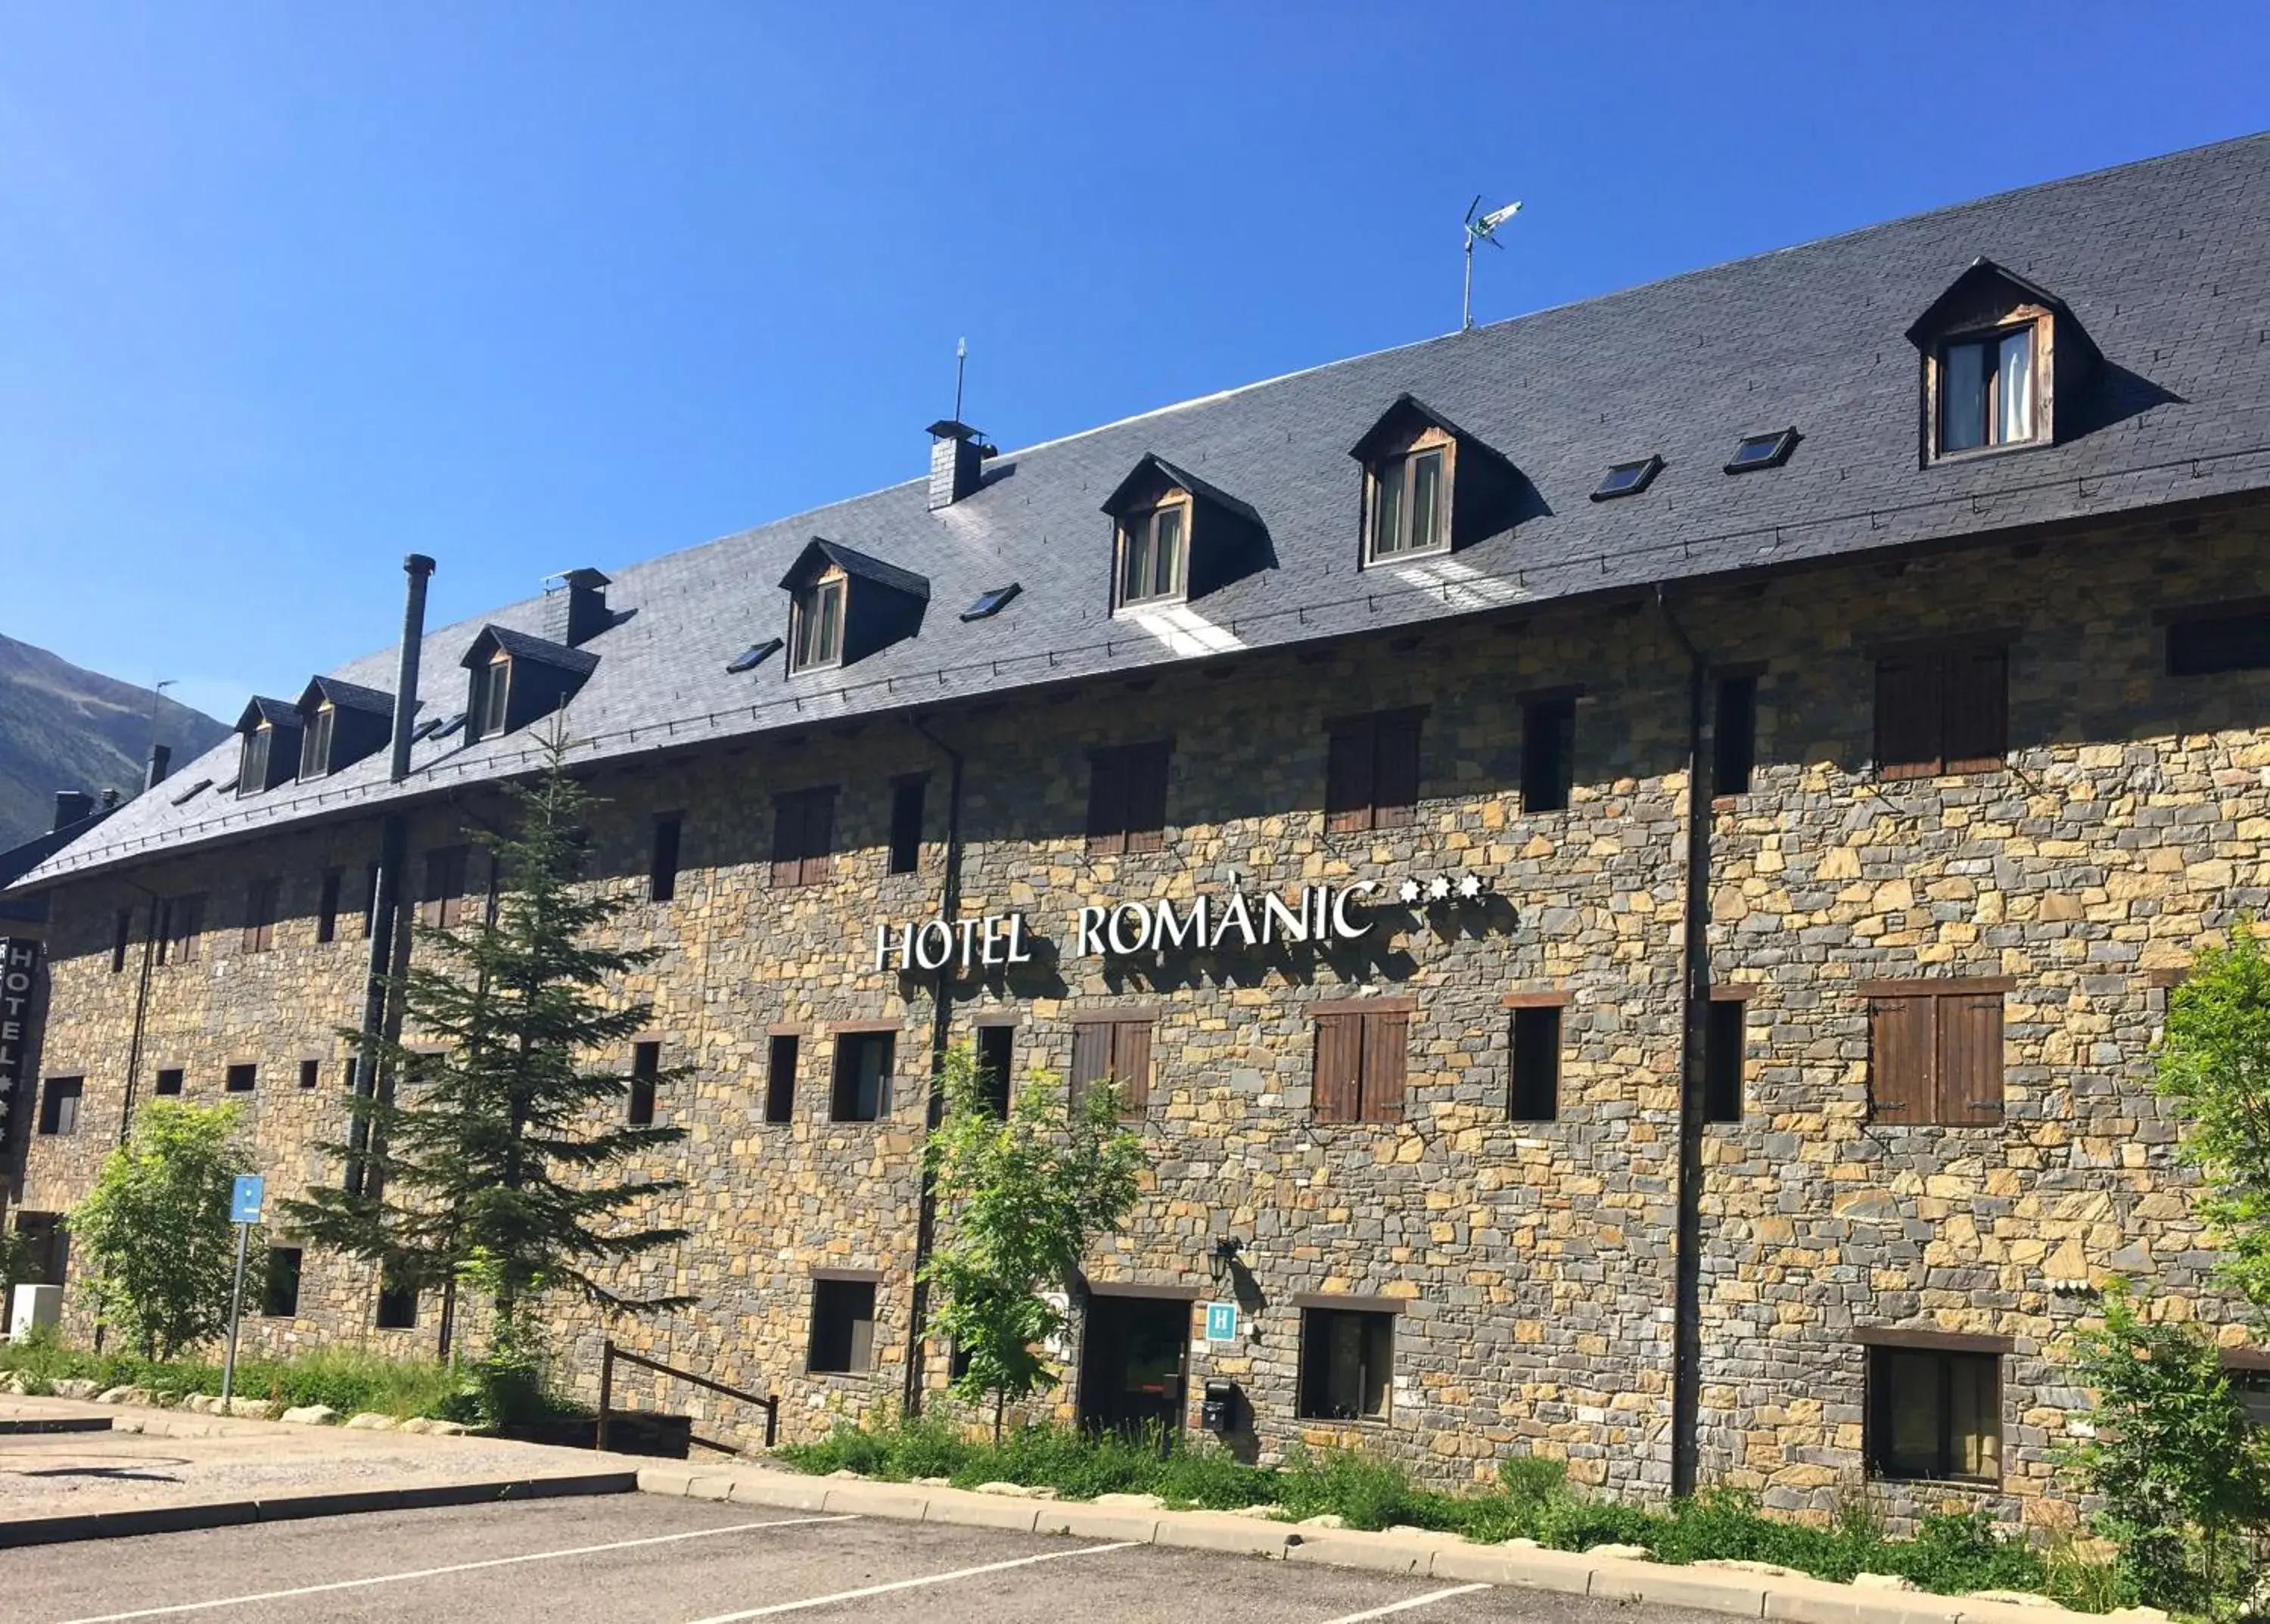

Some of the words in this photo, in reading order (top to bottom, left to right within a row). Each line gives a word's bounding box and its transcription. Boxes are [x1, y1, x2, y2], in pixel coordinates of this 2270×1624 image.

[875, 913, 1031, 971] HOTEL
[1077, 870, 1377, 957] ROMÀNIC
[0, 947, 32, 1065] HOTEL
[1215, 1309, 1228, 1330] H
